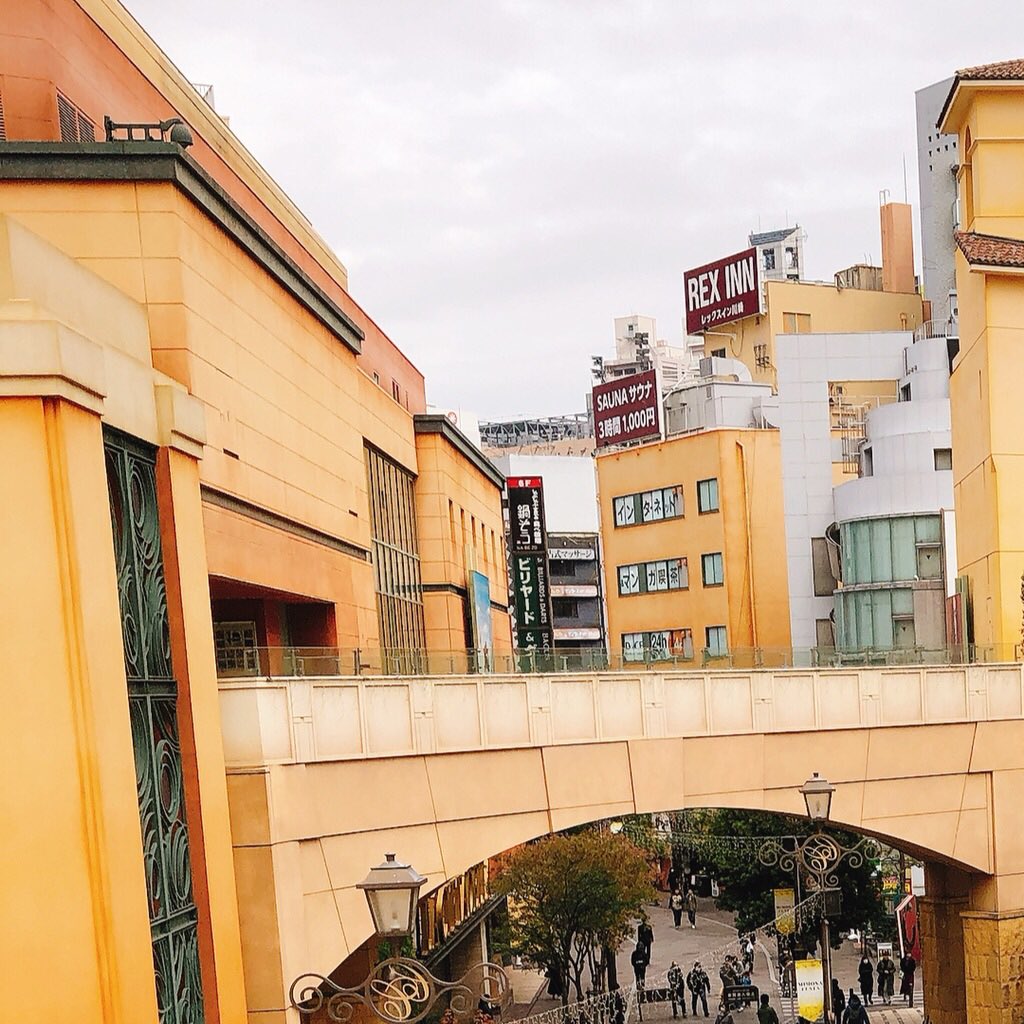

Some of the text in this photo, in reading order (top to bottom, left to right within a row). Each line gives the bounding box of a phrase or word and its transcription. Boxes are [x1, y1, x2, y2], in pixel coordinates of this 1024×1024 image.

[688, 256, 755, 311] REX INN
[597, 380, 652, 412] SAUNA サウナ
[598, 406, 655, 438] 3時間 1,000円
[518, 557, 535, 625] ビリヤード
[651, 633, 667, 649] 24h
